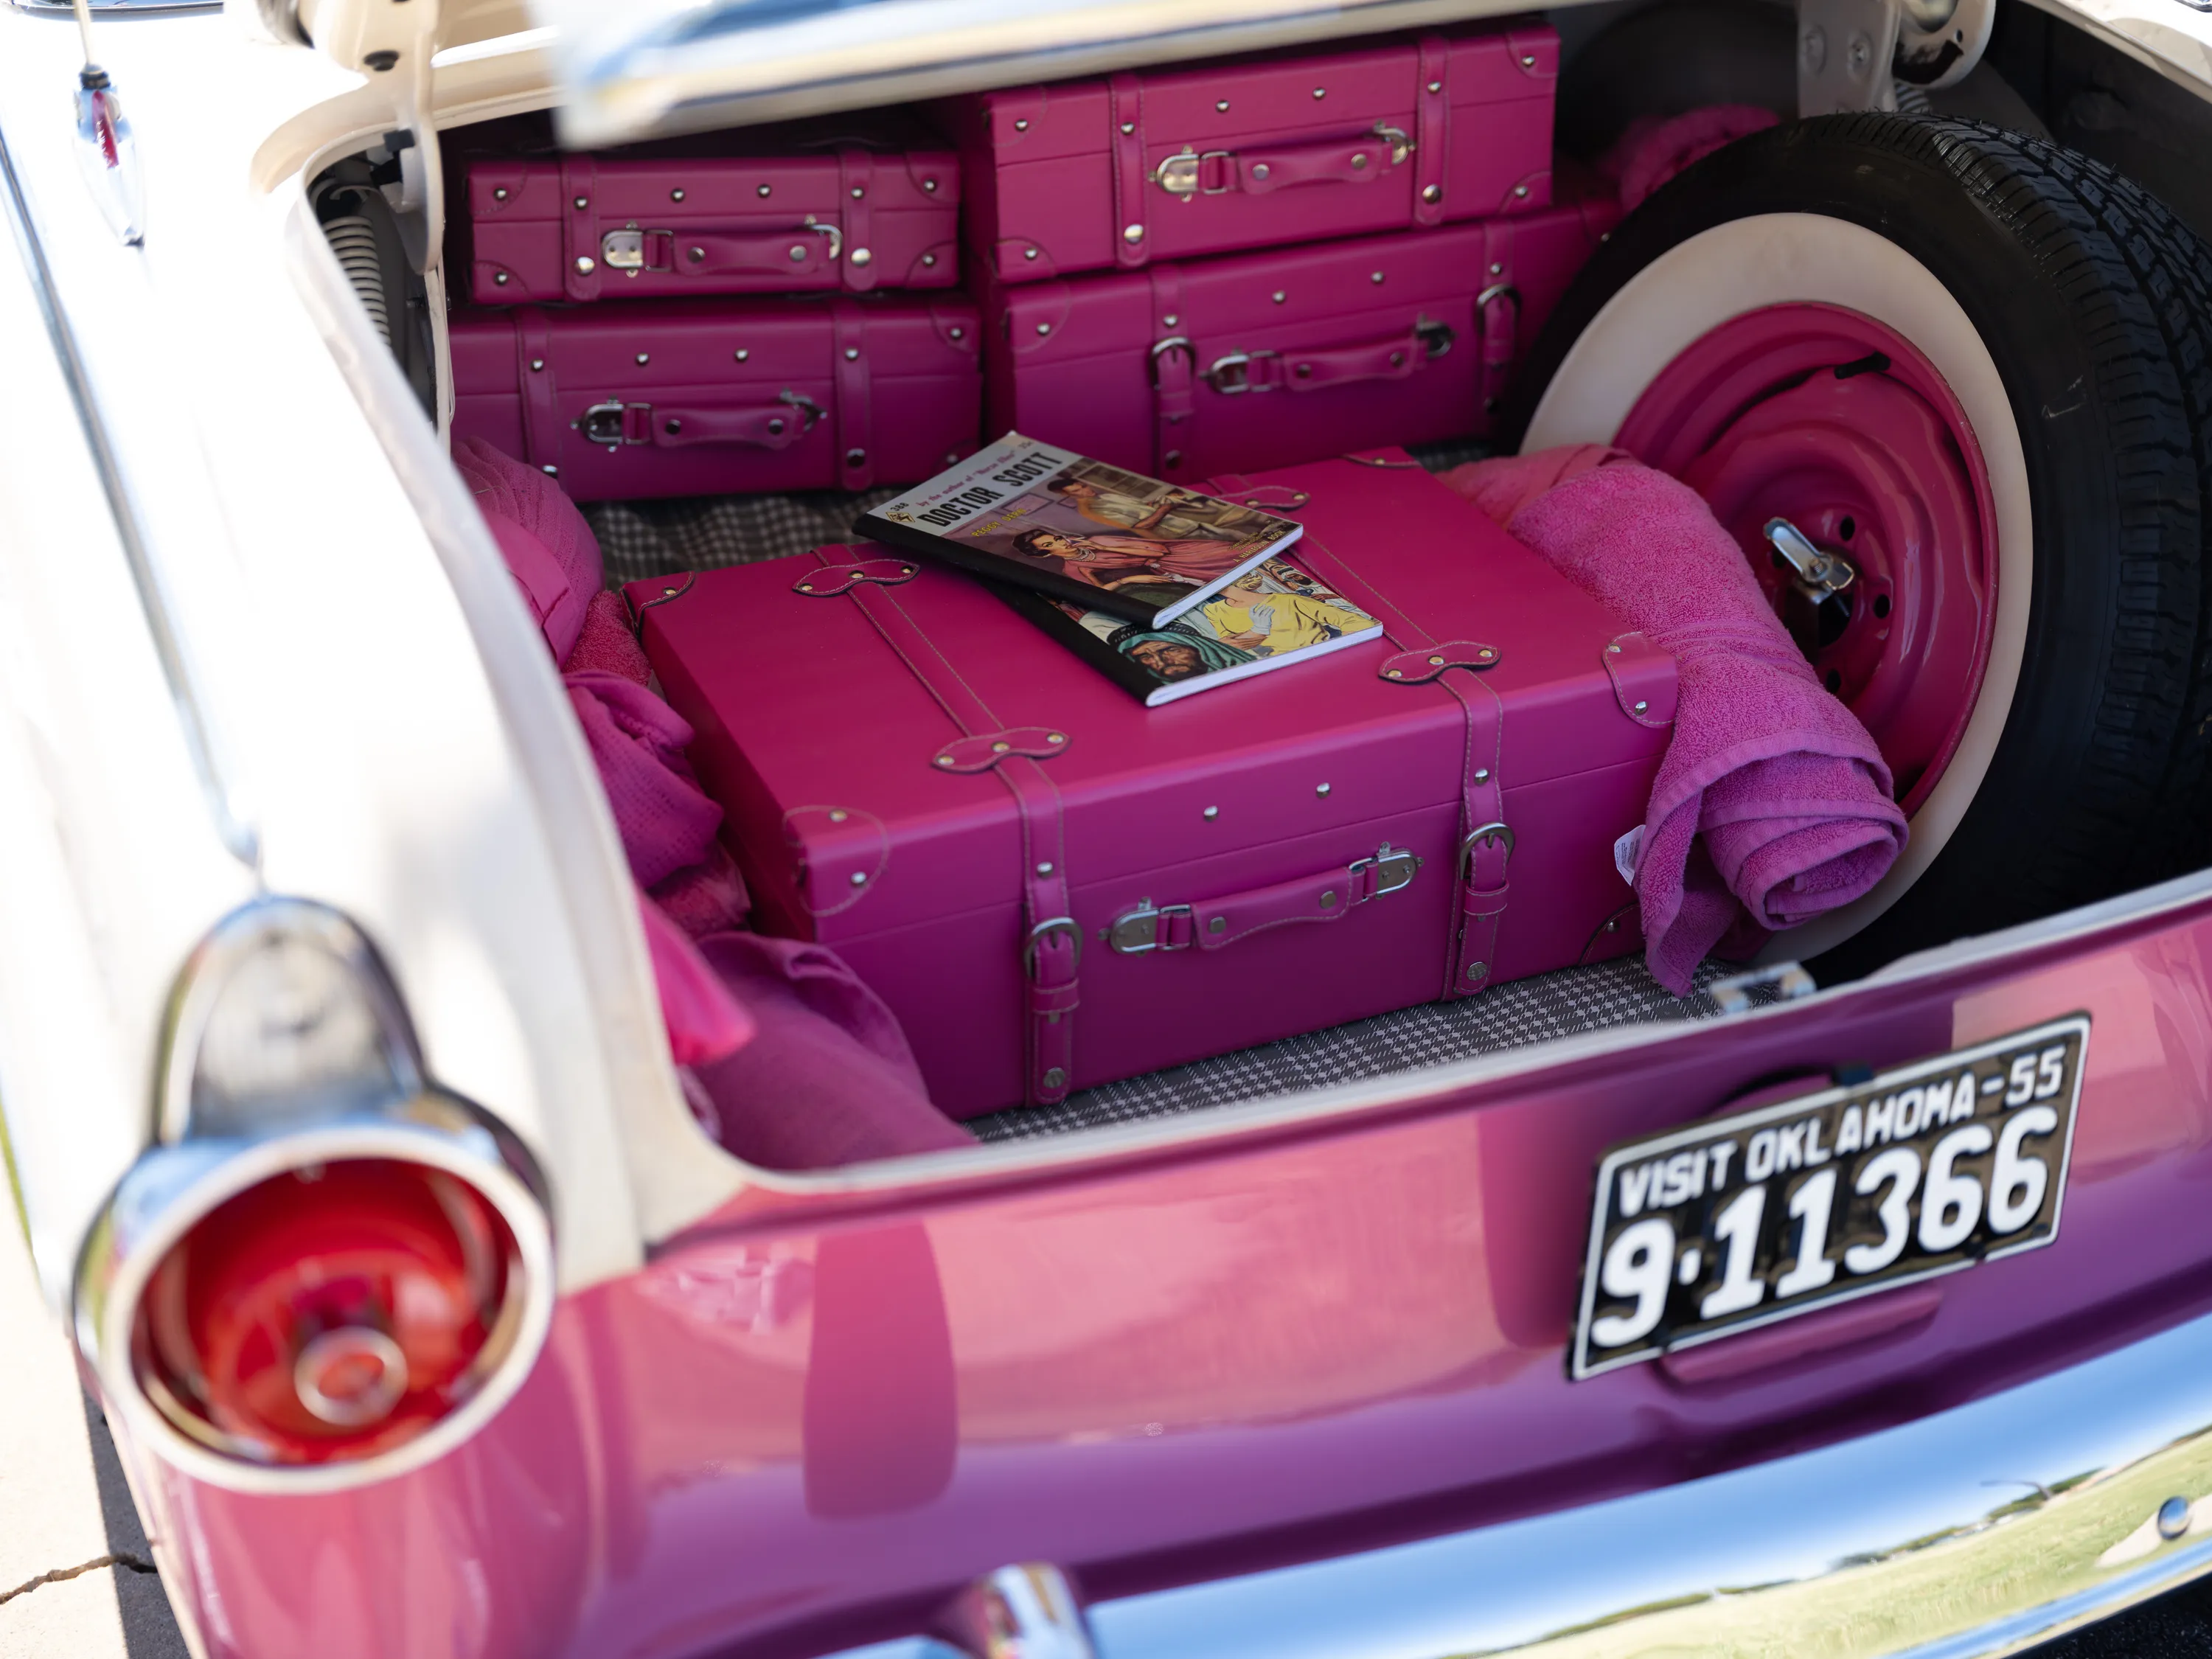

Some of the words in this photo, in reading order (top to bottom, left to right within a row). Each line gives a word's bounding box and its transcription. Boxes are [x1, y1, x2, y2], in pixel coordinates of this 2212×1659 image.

[917, 487, 1005, 526] DOCTOR
[992, 452, 1062, 487] SCOTT
[928, 493, 942, 501] the
[942, 481, 964, 495] author
[890, 502, 909, 511] 388
[972, 521, 1001, 537] PEGGY
[1239, 540, 1270, 558] HARLEQUIN
[1267, 529, 1285, 540] BOOK
[1621, 1140, 1737, 1217] VISIT
